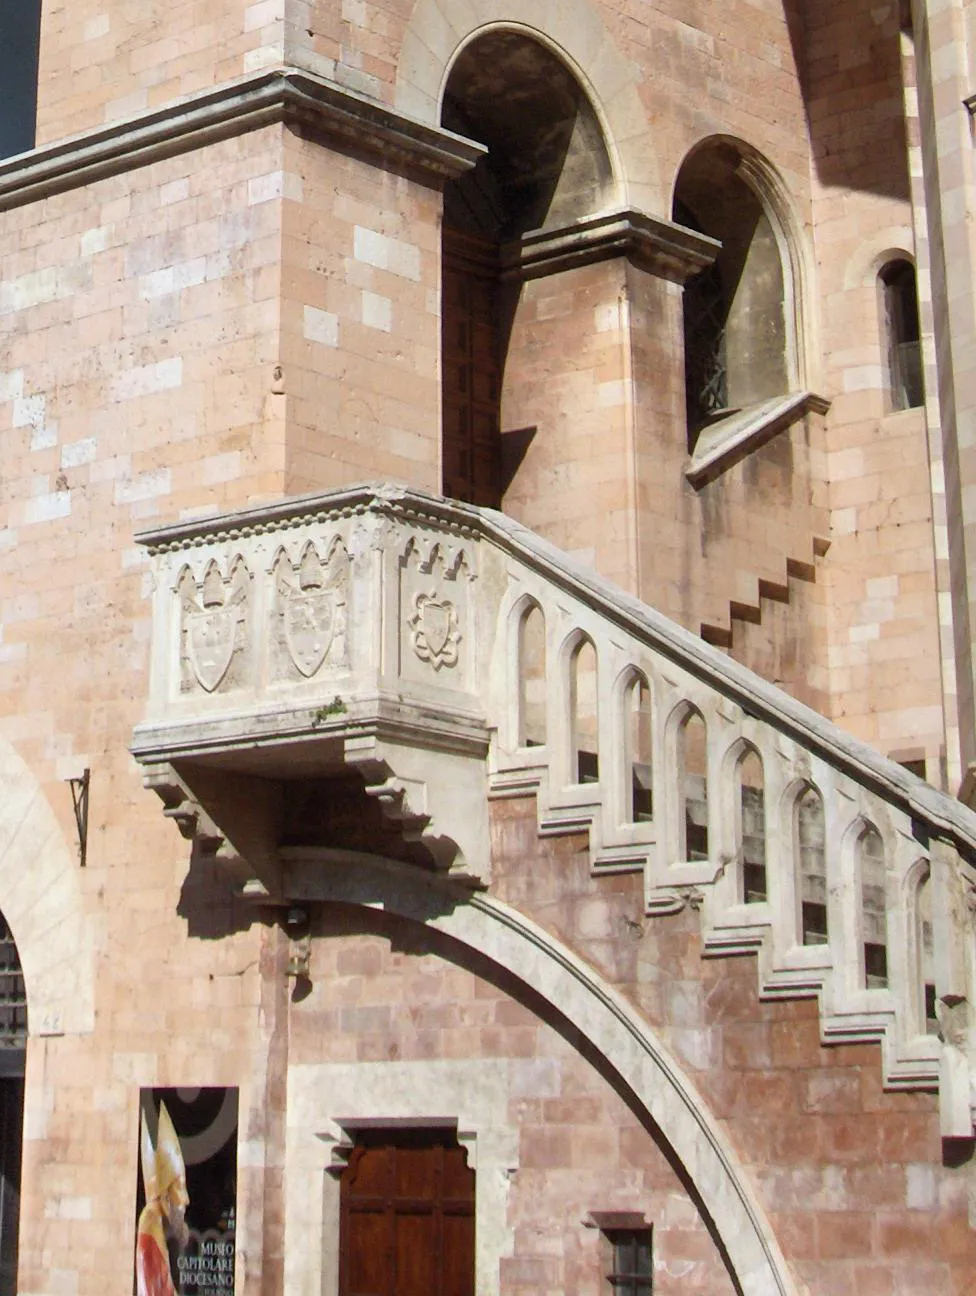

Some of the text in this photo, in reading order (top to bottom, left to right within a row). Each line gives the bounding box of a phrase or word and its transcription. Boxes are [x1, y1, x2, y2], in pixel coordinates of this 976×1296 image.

[201, 1241, 233, 1257] MUSEO
[177, 1255, 232, 1272] CAPITOLARE
[180, 1271, 233, 1287] DIOCESANO
